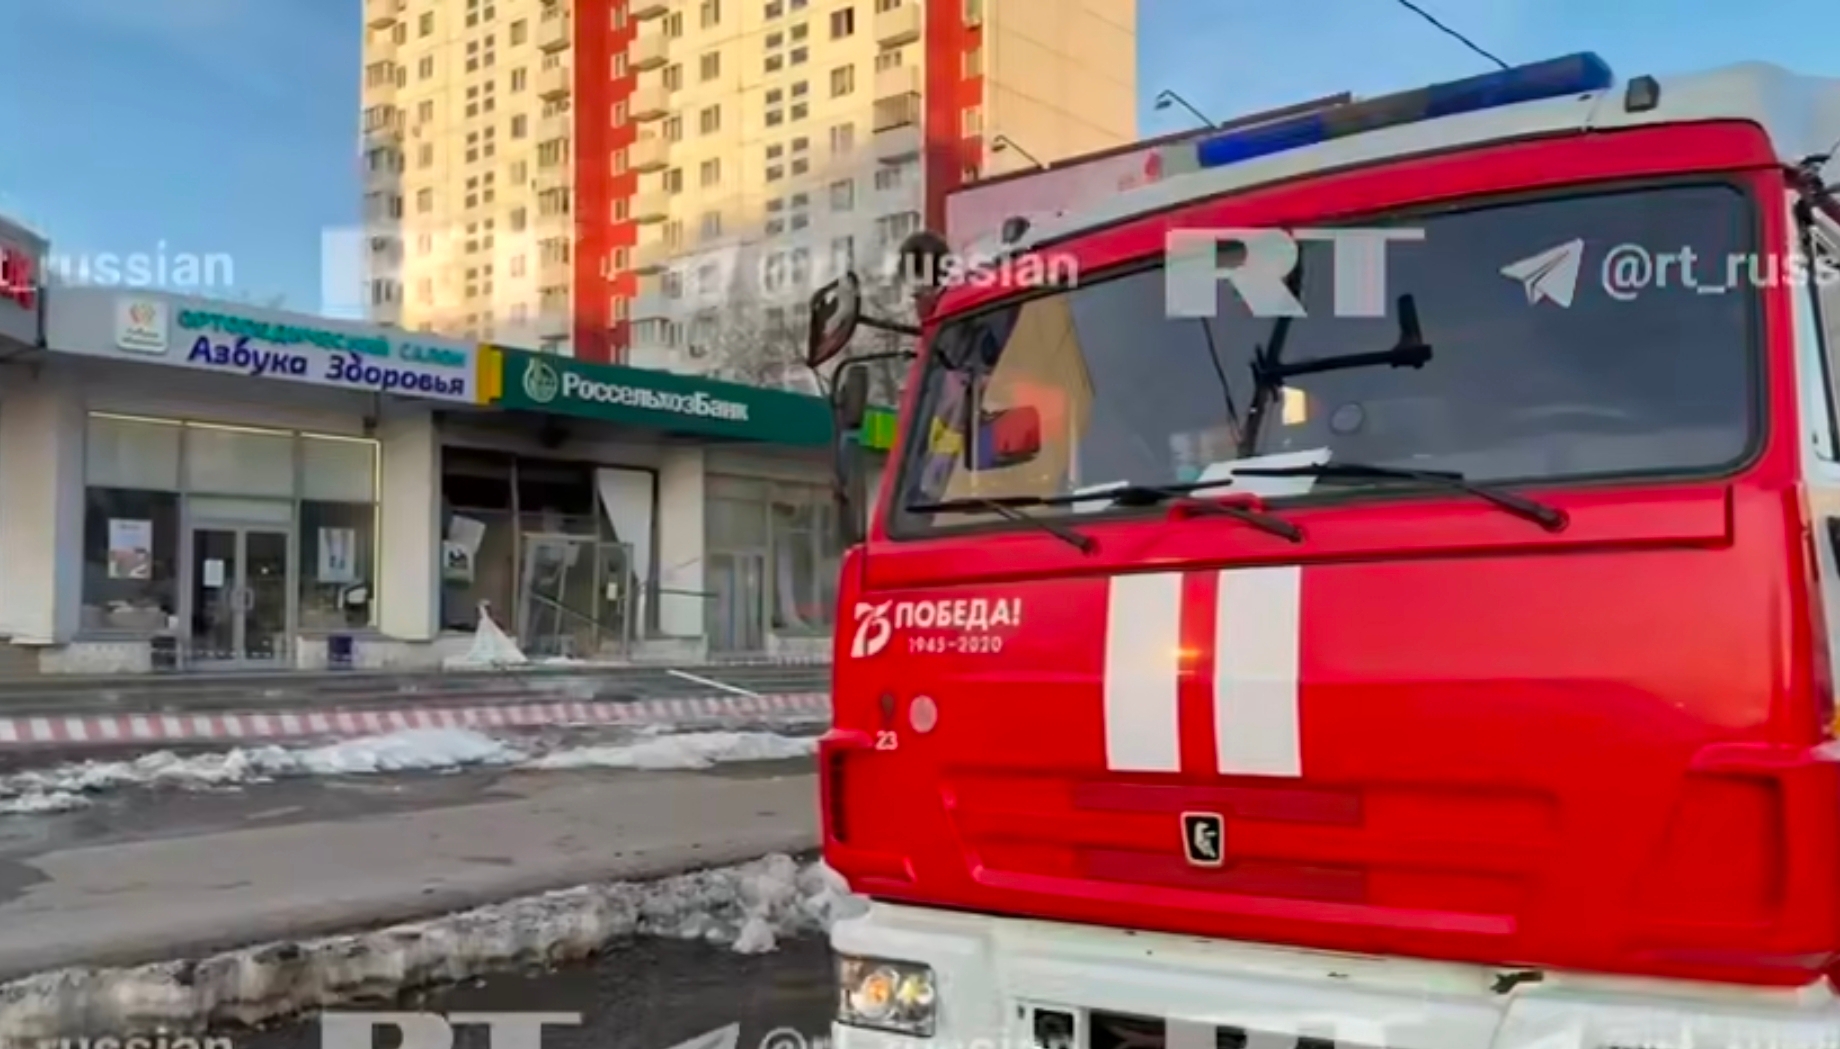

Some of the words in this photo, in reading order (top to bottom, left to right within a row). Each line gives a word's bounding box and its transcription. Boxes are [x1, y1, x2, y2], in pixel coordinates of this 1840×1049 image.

[188, 335, 307, 376] Азбука
[325, 351, 465, 396] Здоровья
[894, 598, 1023, 631] ПОБЕДА!
[875, 729, 899, 751] 23
